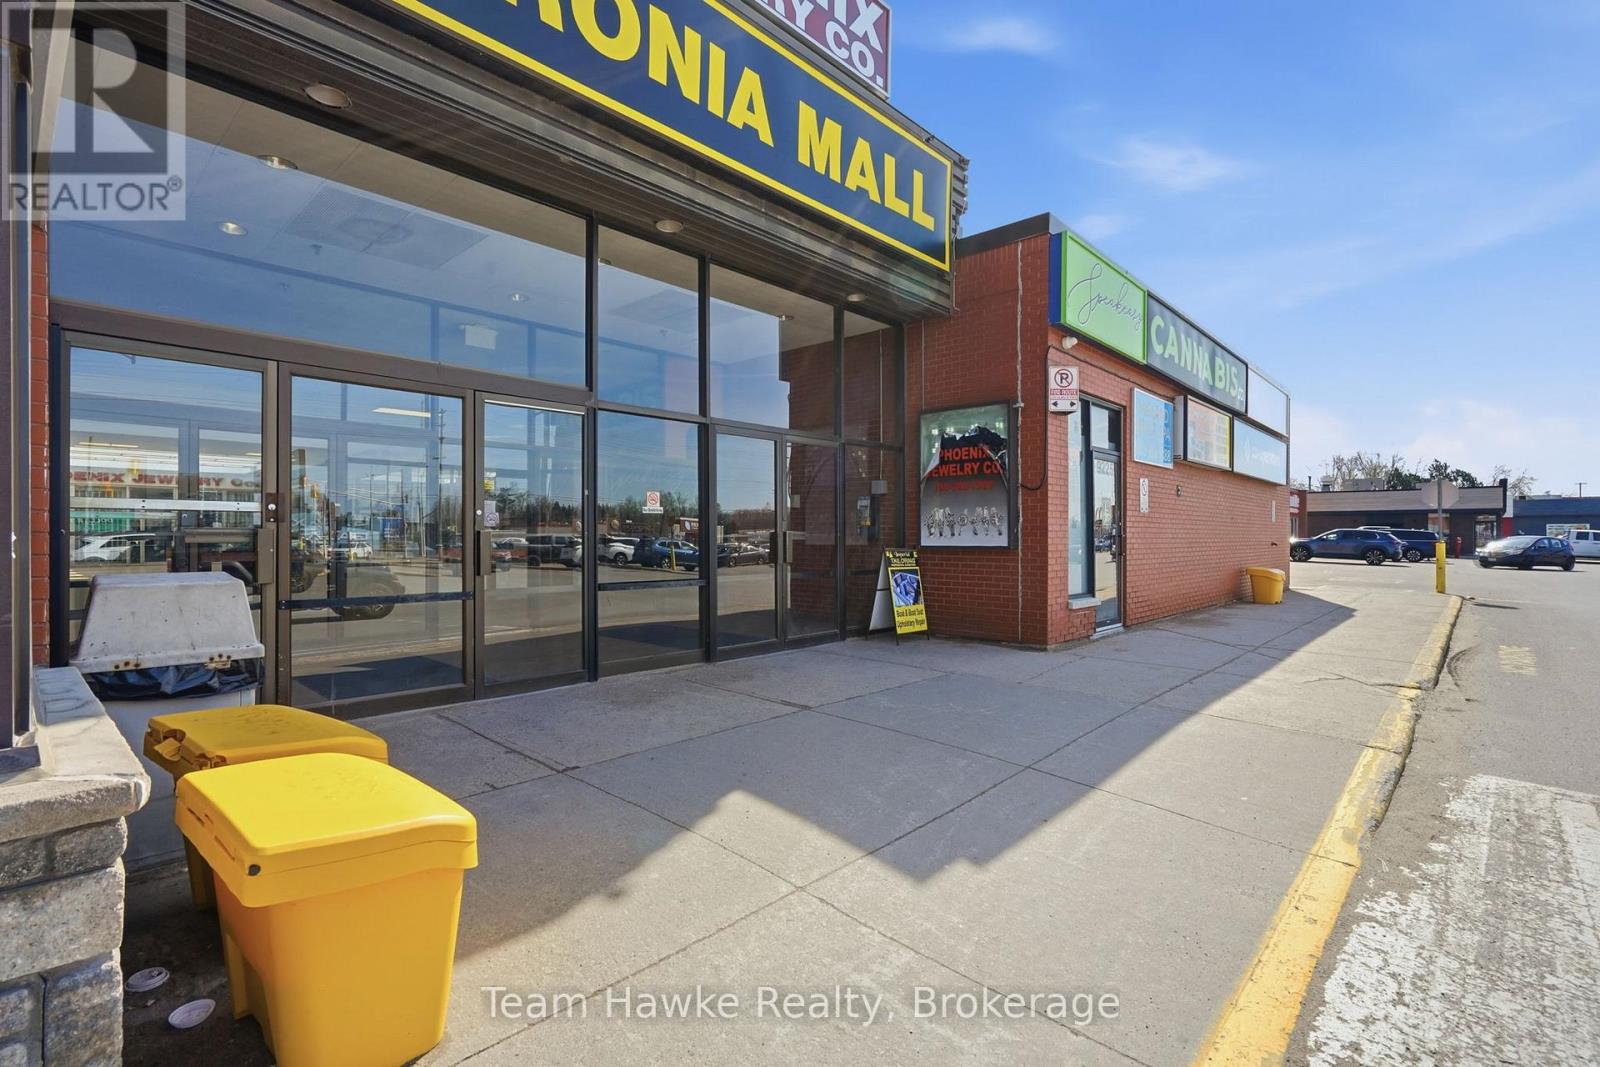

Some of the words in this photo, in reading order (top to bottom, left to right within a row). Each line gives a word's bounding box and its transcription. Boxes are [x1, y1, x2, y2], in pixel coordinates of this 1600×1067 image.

[816, 0, 883, 54] IX
[825, 20, 884, 88] CO.
[505, 0, 775, 147] ONIA
[798, 100, 935, 231] MALL
